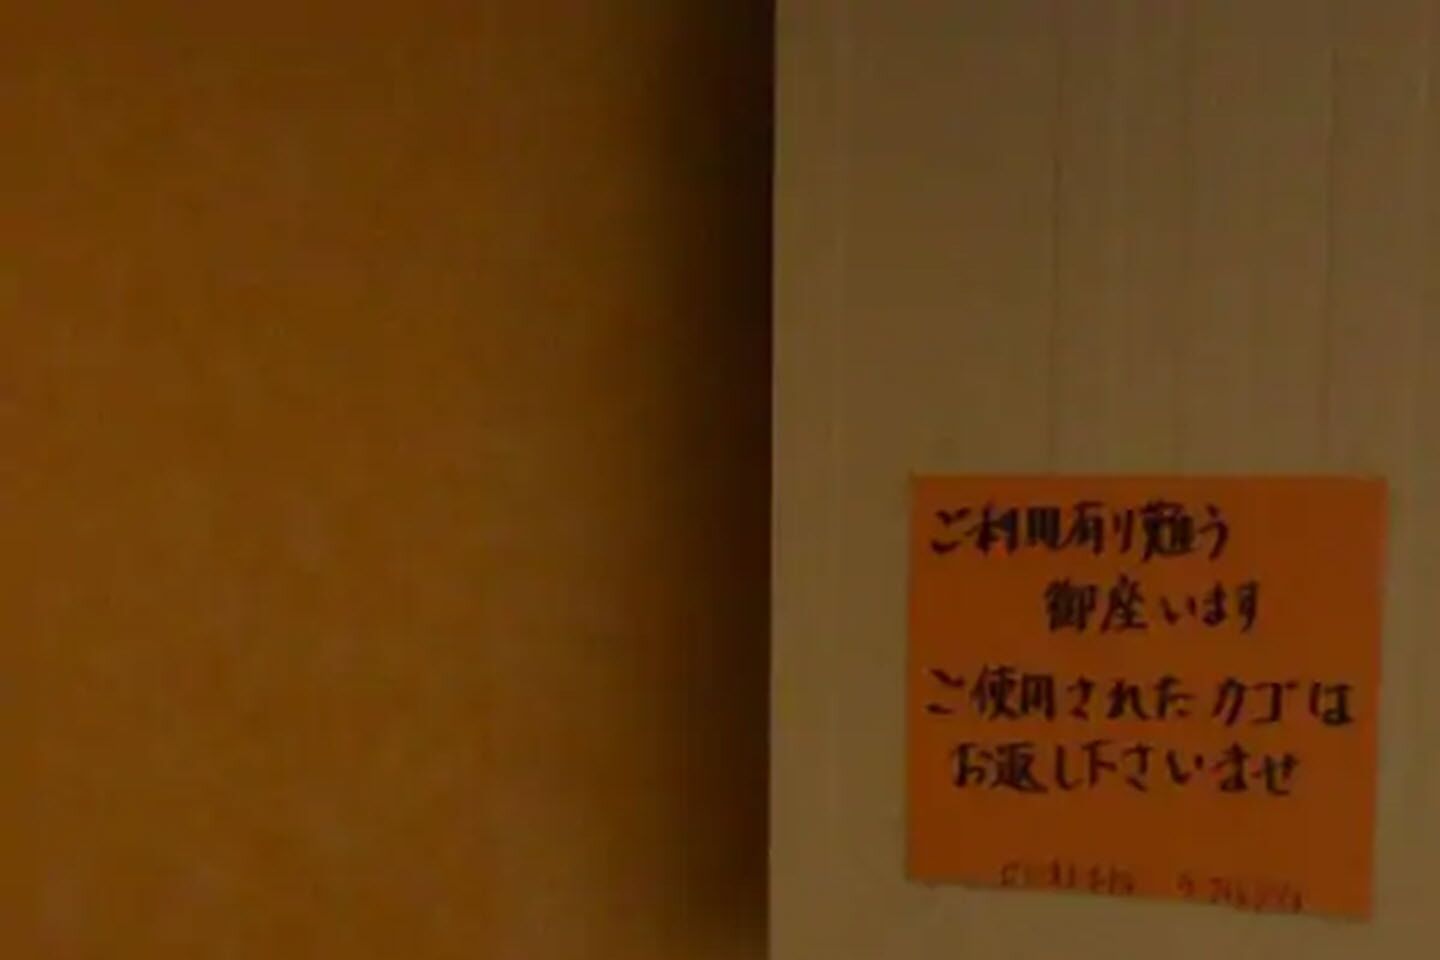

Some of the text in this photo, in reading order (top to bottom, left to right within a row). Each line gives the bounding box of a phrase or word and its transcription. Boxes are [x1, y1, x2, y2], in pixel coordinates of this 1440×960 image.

[1044, 574, 1261, 632] 御座います
[950, 740, 1301, 797] お返し下さいませ
